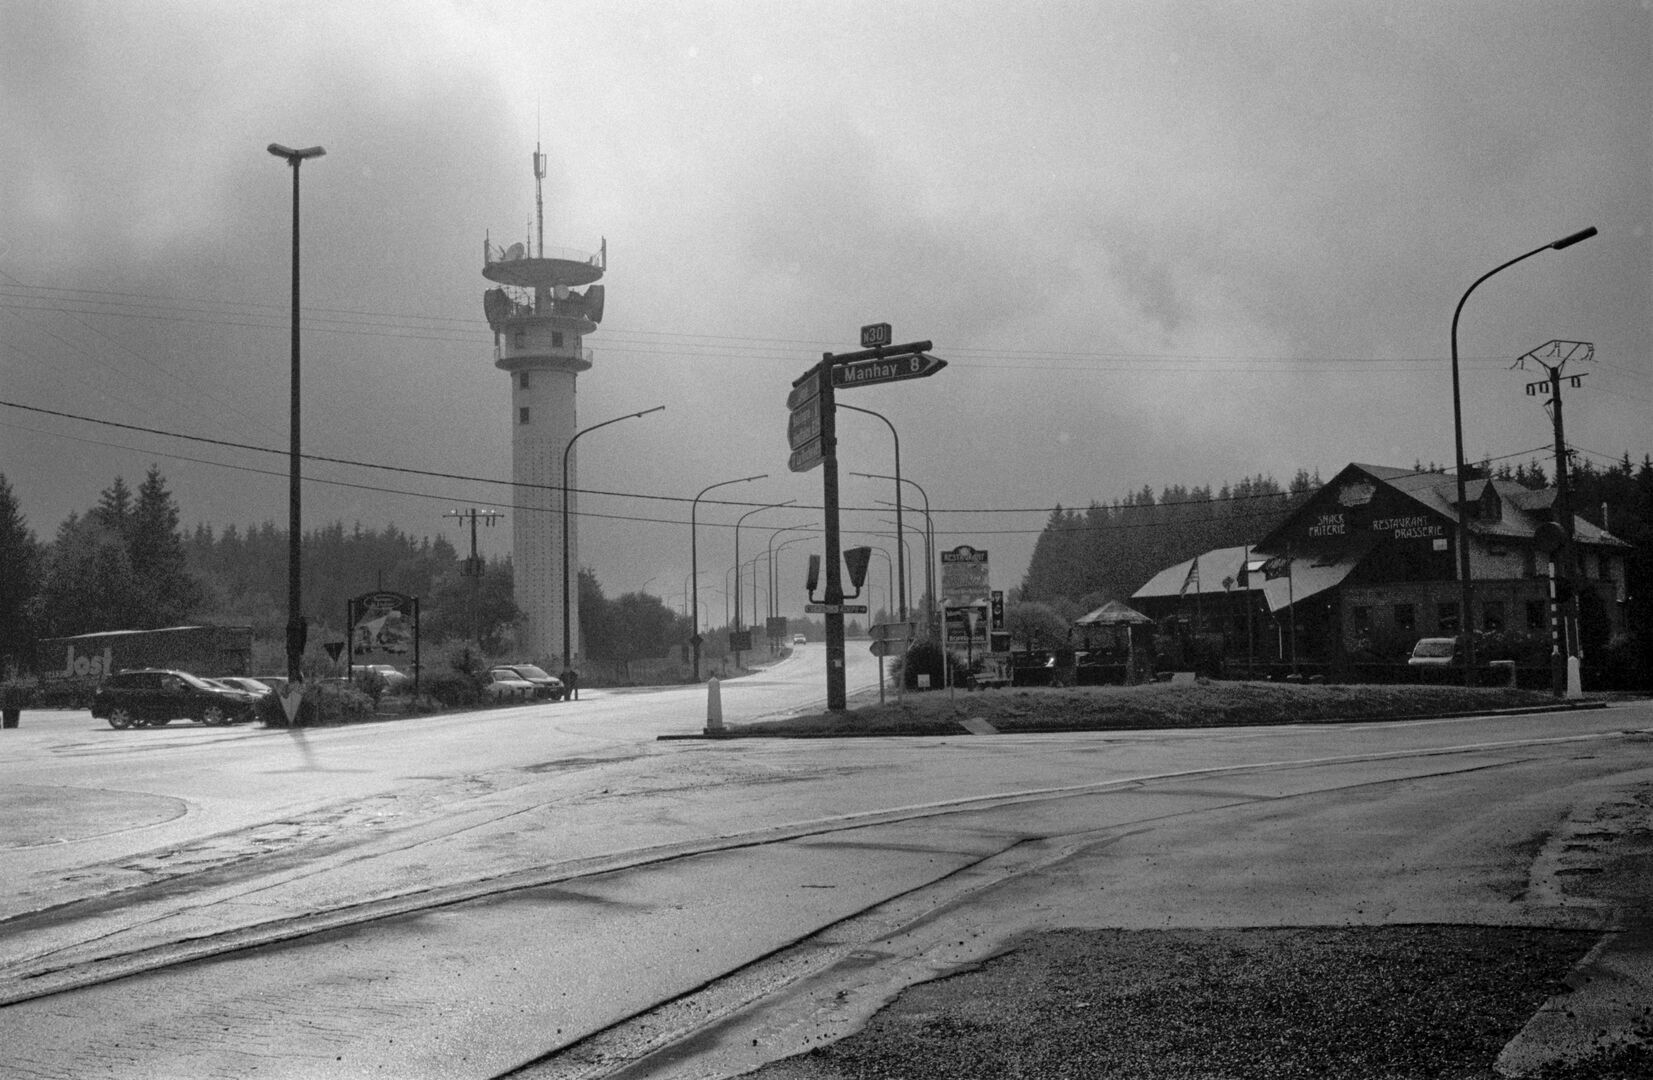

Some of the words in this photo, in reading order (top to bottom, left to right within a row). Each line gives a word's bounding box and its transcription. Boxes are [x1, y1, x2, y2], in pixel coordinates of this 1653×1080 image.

[863, 326, 883, 343] N30
[844, 363, 897, 382] Manhay
[910, 357, 919, 372] 8
[1317, 513, 1344, 526] SNACK
[1373, 515, 1428, 531] RESTAURANT
[1394, 525, 1443, 539] BRASSERIE
[60, 645, 113, 678] Jost
